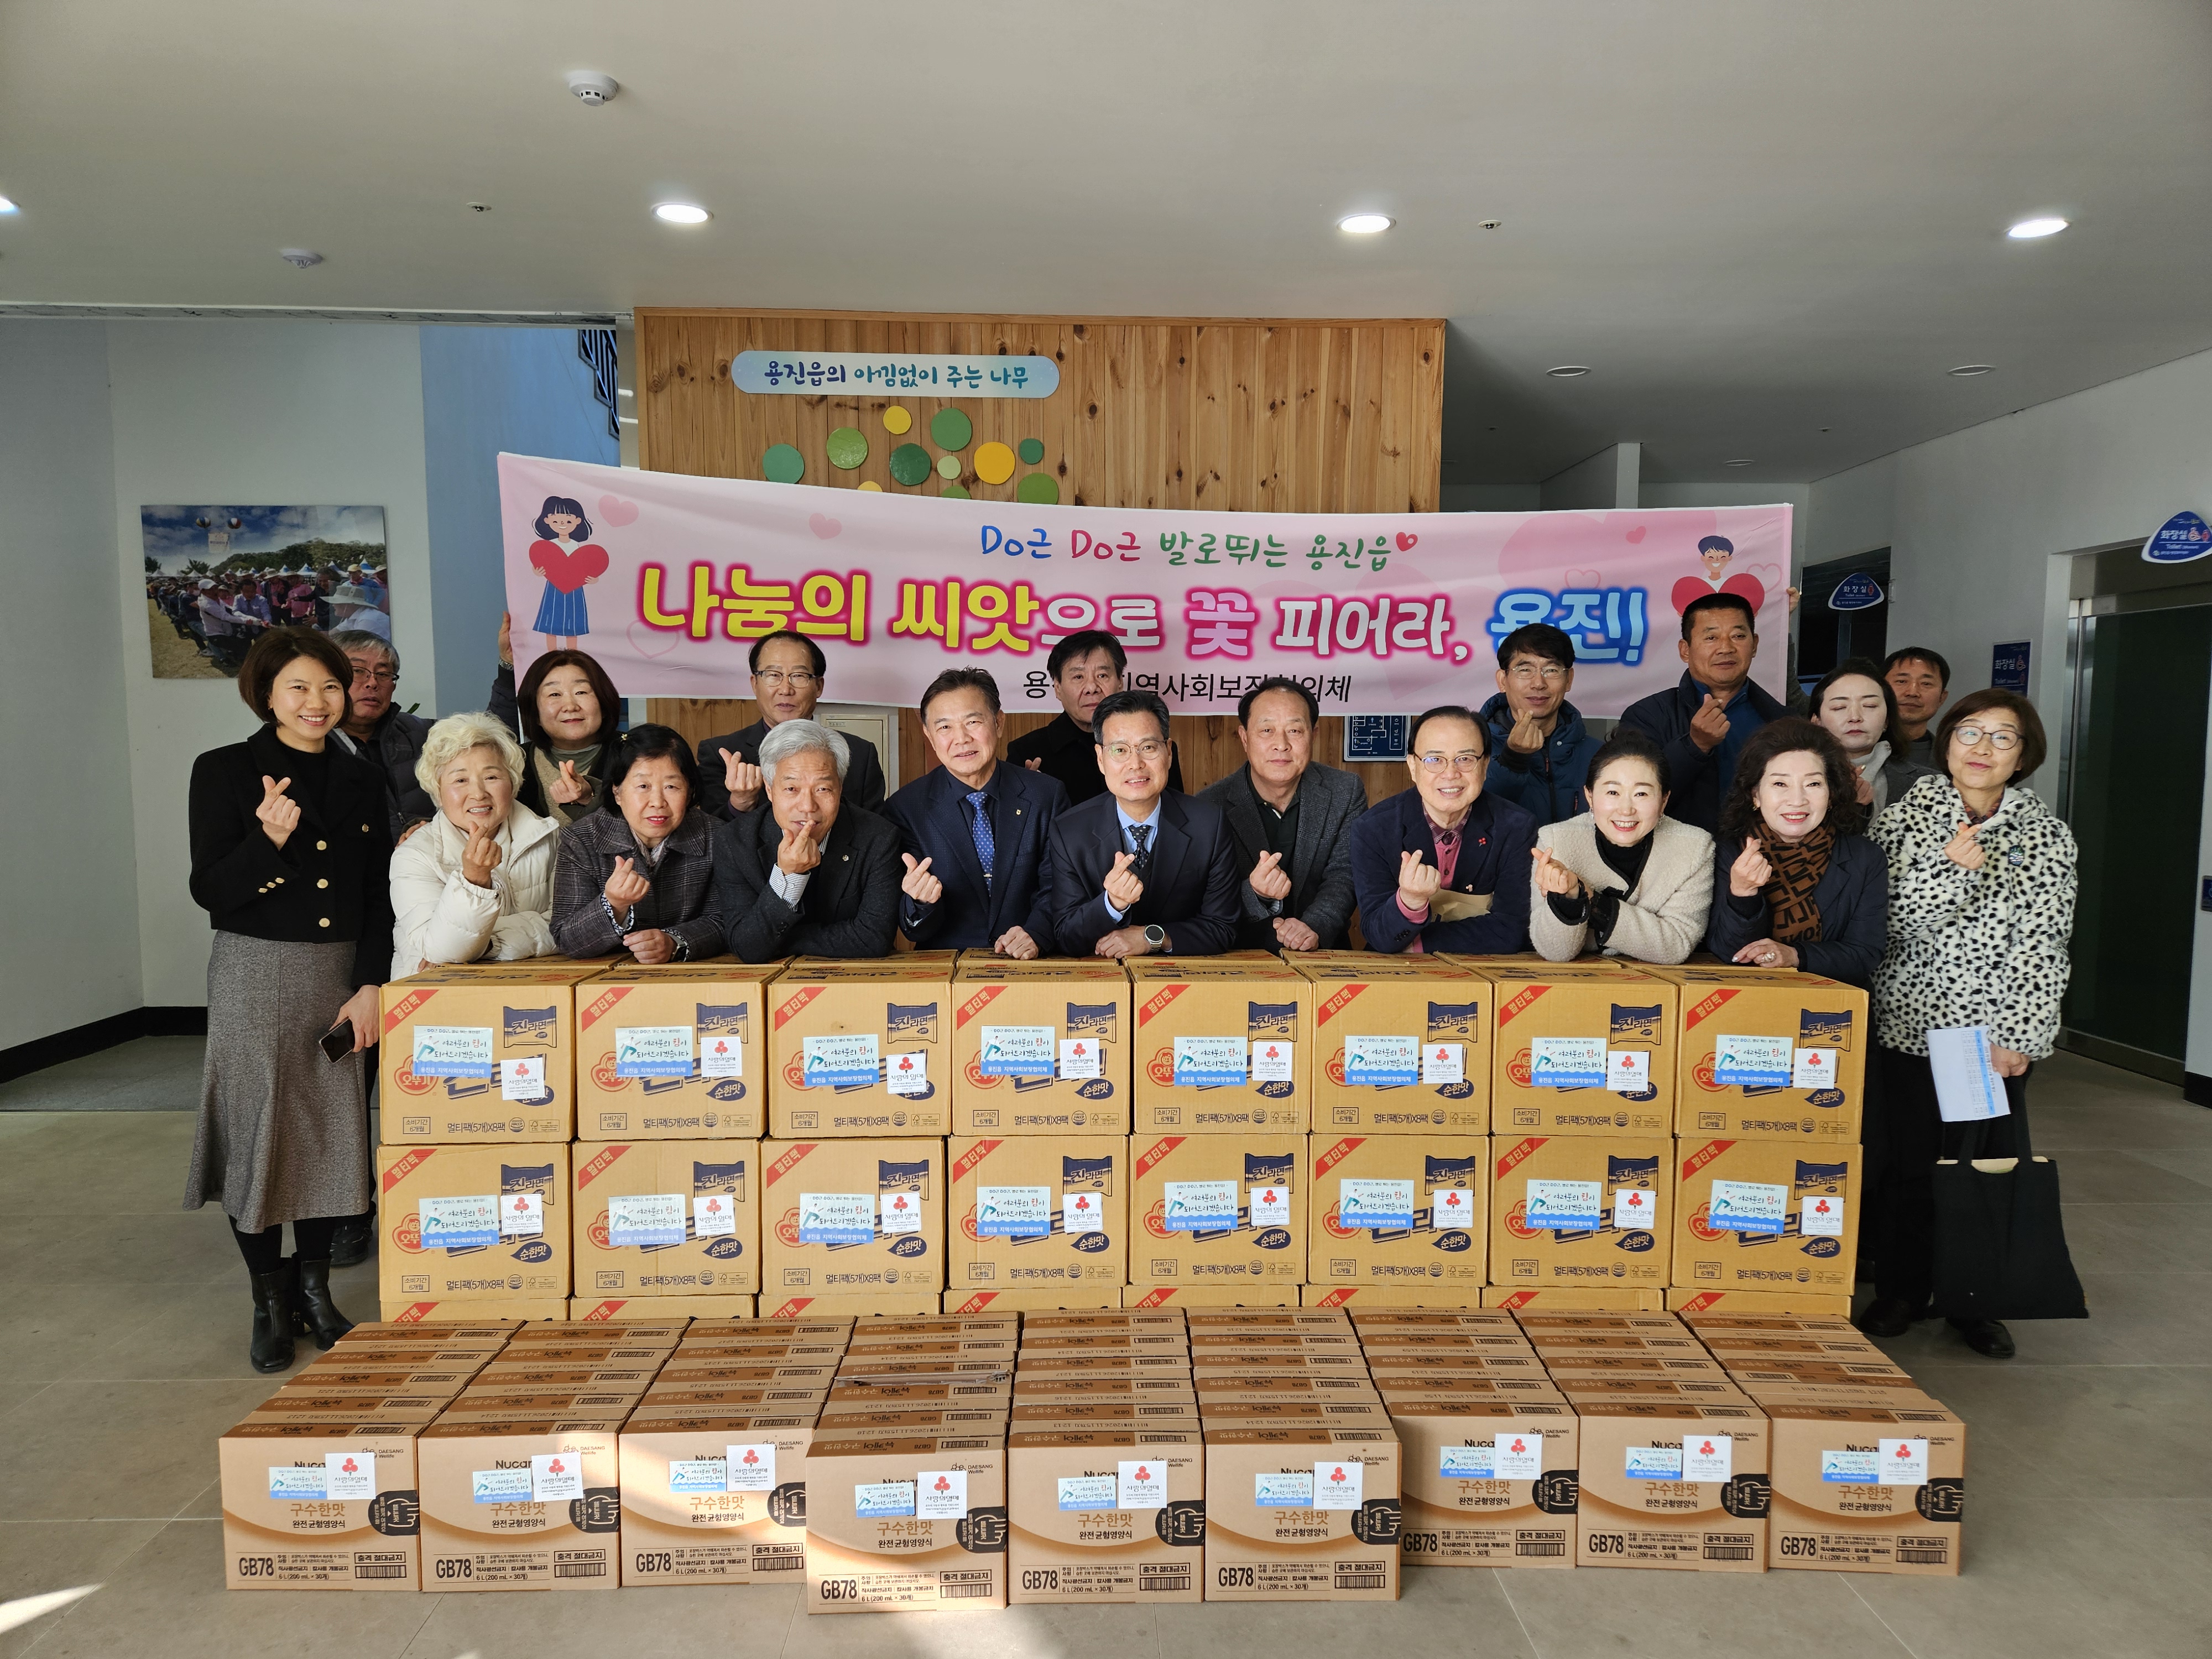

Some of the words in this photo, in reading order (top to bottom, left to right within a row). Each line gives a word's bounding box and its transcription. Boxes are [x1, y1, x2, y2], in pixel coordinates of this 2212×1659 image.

[765, 361, 846, 386] 용진읍의
[854, 364, 937, 387] 아낌없이
[947, 365, 983, 389] 주는
[990, 367, 1029, 389] 나무
[2160, 530, 2188, 540] 화장실
[1160, 531, 1288, 568] 발로뛰는
[1306, 535, 1391, 572] 용진읍
[642, 567, 866, 641] 나눔의
[893, 582, 1160, 652] 씨앗으로
[1190, 592, 1255, 655] 꽃
[1276, 598, 1467, 660] 피어라,
[1995, 659, 2015, 670] 화장실
[393, 994, 421, 1020] 멀티팩
[589, 992, 617, 1017] 멀티팩
[782, 992, 809, 1017] 멀티팩
[964, 990, 990, 1016] 멀티팩
[1147, 989, 1173, 1014] 멀티팩
[1326, 989, 1352, 1014] 멀티팩
[1508, 989, 1534, 1014] 멀티팩
[1695, 993, 1723, 1018] 멀티팩
[512, 1020, 547, 1036] 진라면
[705, 1016, 738, 1030] 진라면
[895, 1015, 927, 1030] 진라면
[1074, 1015, 1107, 1030] 진라면
[1256, 1014, 1288, 1029] 진라면
[1436, 1015, 1468, 1029] 진라면
[1619, 1016, 1652, 1031] 진라면
[1808, 1022, 1842, 1036] 진라면
[442, 1039, 469, 1048] 여러분의
[472, 1039, 487, 1048] 힘이
[644, 1039, 670, 1048] 여러분의
[673, 1039, 687, 1047] 힘이
[1008, 1038, 1033, 1047] 여러분의
[1036, 1037, 1049, 1046] 힘이
[435, 1051, 488, 1060] 되어드리겠습니다
[637, 1050, 688, 1058] 되어드리겠습니다
[831, 1048, 856, 1057] 여러분의
[859, 1046, 873, 1055] 힘이
[1001, 1050, 1051, 1058] 되어드리겠습니다
[1201, 1048, 1225, 1057] 여러분의
[1228, 1048, 1241, 1057] 힘이
[1371, 1048, 1397, 1057] 여러분의
[1399, 1047, 1412, 1056] 힘이
[1558, 1050, 1584, 1058] 여러분의
[1587, 1049, 1600, 1058] 힘이
[1744, 1048, 1768, 1057] 여러분의
[1772, 1048, 1785, 1057] 힘이
[824, 1058, 875, 1067] 되어드리겠습니다
[1193, 1060, 1243, 1068] 되어드리겠습니다
[1364, 1059, 1414, 1067] 되어드리겠습니다
[1551, 1061, 1601, 1069] 되어드리겠습니다
[644, 1118, 699, 1128] 멀티팩(5개)X8팩
[834, 1116, 889, 1126] 멀티팩(5개)X8팩
[1015, 1115, 1068, 1125] 멀티팩(5개)X8팩
[1196, 1113, 1249, 1123] 멀티팩(5개)X8팩
[1374, 1113, 1428, 1124] 멀티팩(5개)X8팩
[1556, 1115, 1610, 1125] 멀티팩(5개)X8팩
[1742, 1120, 1797, 1131] 멀티팩(5개)X8팩
[448, 1123, 505, 1133] 멀티팩(5개)X8팩
[961, 1144, 987, 1169] 멀티팩
[1144, 1141, 1170, 1166] 멀티팩
[1323, 1142, 1349, 1167] 멀티팩
[1505, 1142, 1531, 1167] 멀티팩
[1692, 1144, 1718, 1168] 멀티팩
[392, 1154, 419, 1180] 멀티팩
[586, 1150, 614, 1176] 멀티팩
[774, 1149, 801, 1174] 멀티팩
[1079, 1235, 1105, 1250] 순한맛
[1261, 1232, 1286, 1247] 순한맛
[1441, 1234, 1466, 1249] 순한맛
[1624, 1234, 1650, 1249] 순한맛
[520, 1245, 547, 1260] 순한맛
[711, 1241, 737, 1257] 순한맛
[896, 1240, 922, 1255] 순한맛
[1808, 1240, 1835, 1255] 순한맛
[1010, 1268, 1064, 1279] 멀티팩(5개)X8팩
[1193, 1264, 1246, 1275] 멀티팩(5개)X8팩
[1371, 1266, 1425, 1276] 멀티팩(5개)X8팩
[1554, 1266, 1609, 1276] 멀티팩(5개)X8팩
[1737, 1269, 1792, 1281] 멀티팩(5개)X8팩
[447, 1280, 504, 1290] 멀티팩(5개)X8팩
[640, 1276, 696, 1286] 멀티팩(5개)X8팩
[826, 1274, 880, 1284] 멀티팩(5개)X8팩
[1458, 1480, 1511, 1494] 구수한맛
[1645, 1482, 1699, 1497] 구수한맛
[1838, 1486, 1893, 1500] 구수한맛
[290, 1503, 346, 1517] 구수한맛
[490, 1502, 546, 1516] 구수한맛
[690, 1496, 744, 1510] 구수한맛
[1078, 1513, 1133, 1528] 구수한맛
[1274, 1511, 1329, 1525] 구수한맛
[877, 1521, 933, 1536] 구수한맛
[1404, 1533, 1437, 1552] GB78
[1589, 1534, 1624, 1553] GB78
[1781, 1536, 1816, 1556] GB78
[239, 1558, 274, 1576] GB78
[436, 1559, 472, 1578] GB78
[637, 1553, 671, 1572] GB78
[1022, 1570, 1058, 1589] GB78
[1219, 1567, 1254, 1587] GB78
[821, 1579, 857, 1599] GB78
